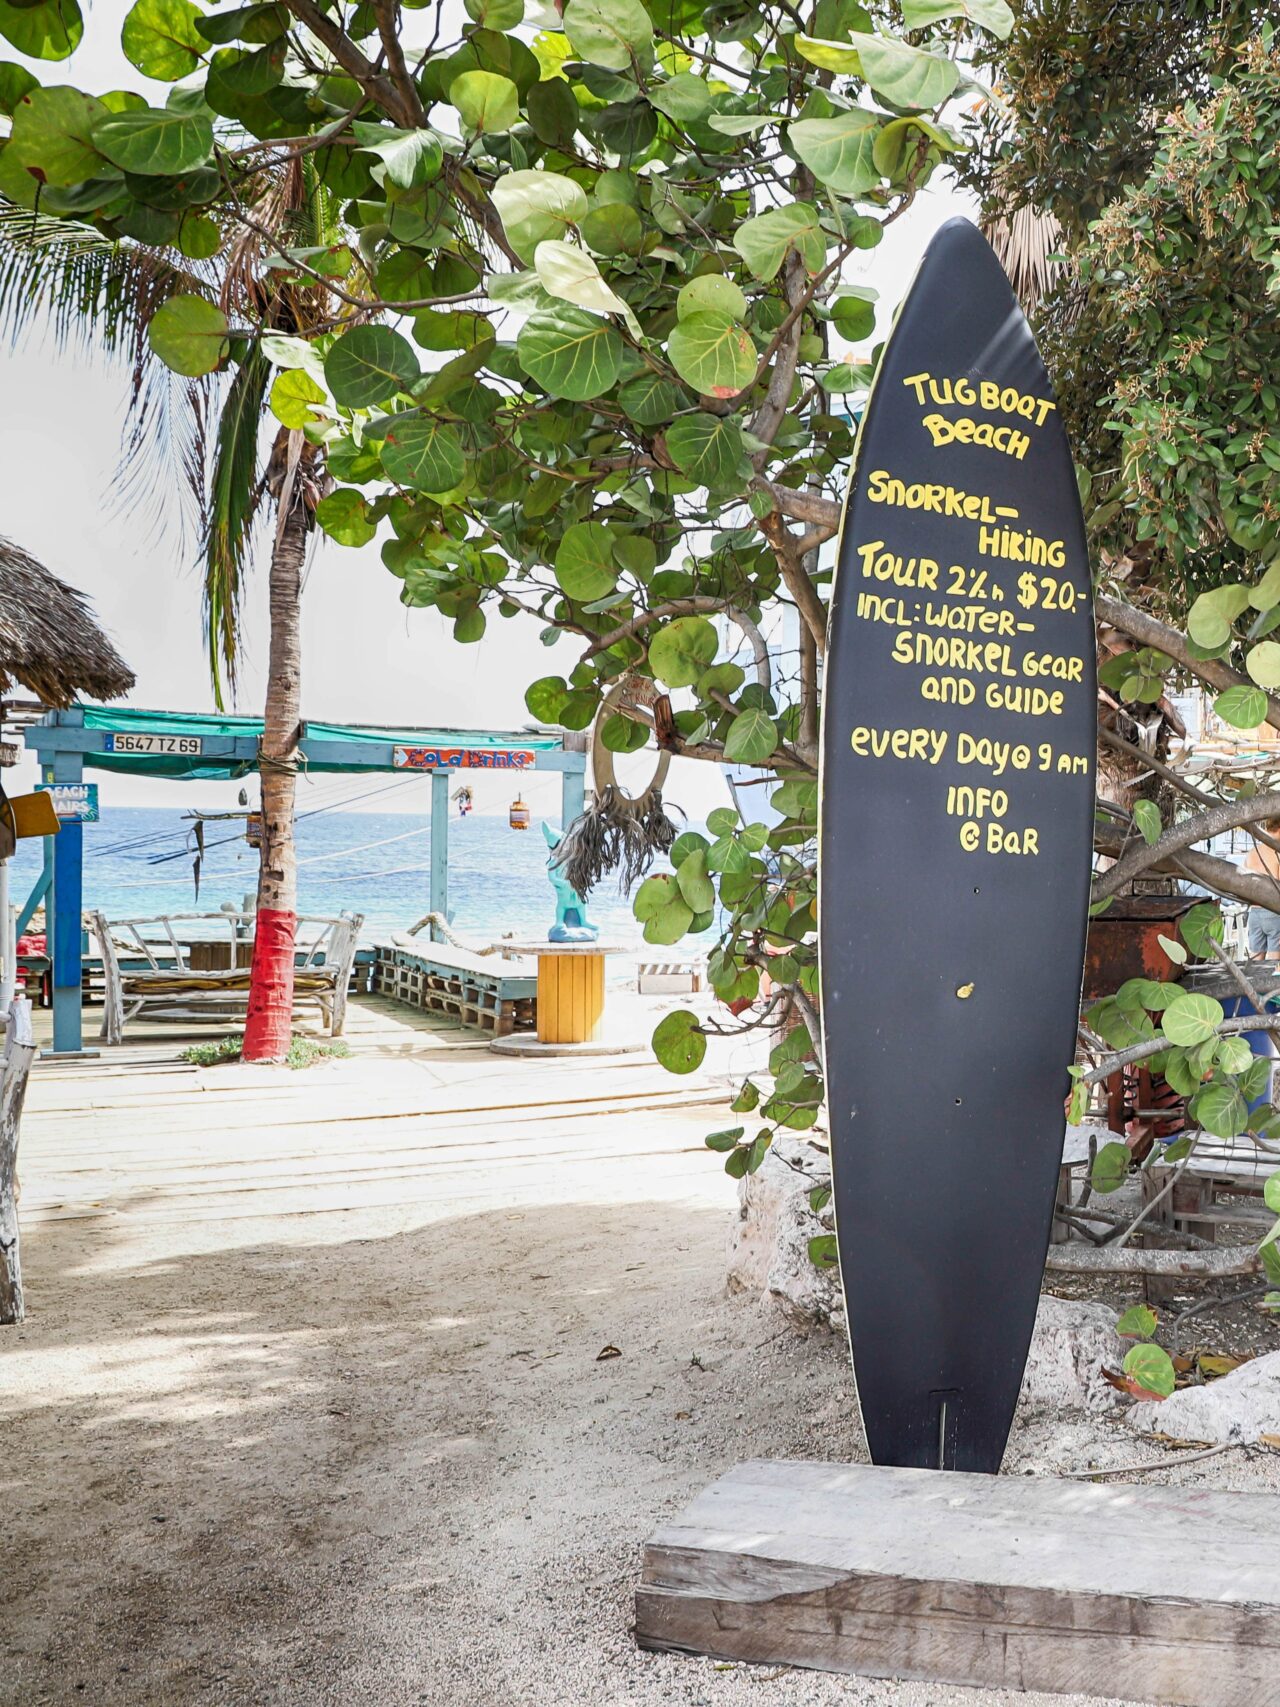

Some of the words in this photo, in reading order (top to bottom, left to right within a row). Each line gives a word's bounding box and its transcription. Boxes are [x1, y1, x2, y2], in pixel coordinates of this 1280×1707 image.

[857, 541, 939, 591] TOUR
[115, 735, 154, 750] 5647
[157, 738, 176, 752] TZ
[179, 739, 198, 753] 69
[1038, 743, 1052, 771] 9
